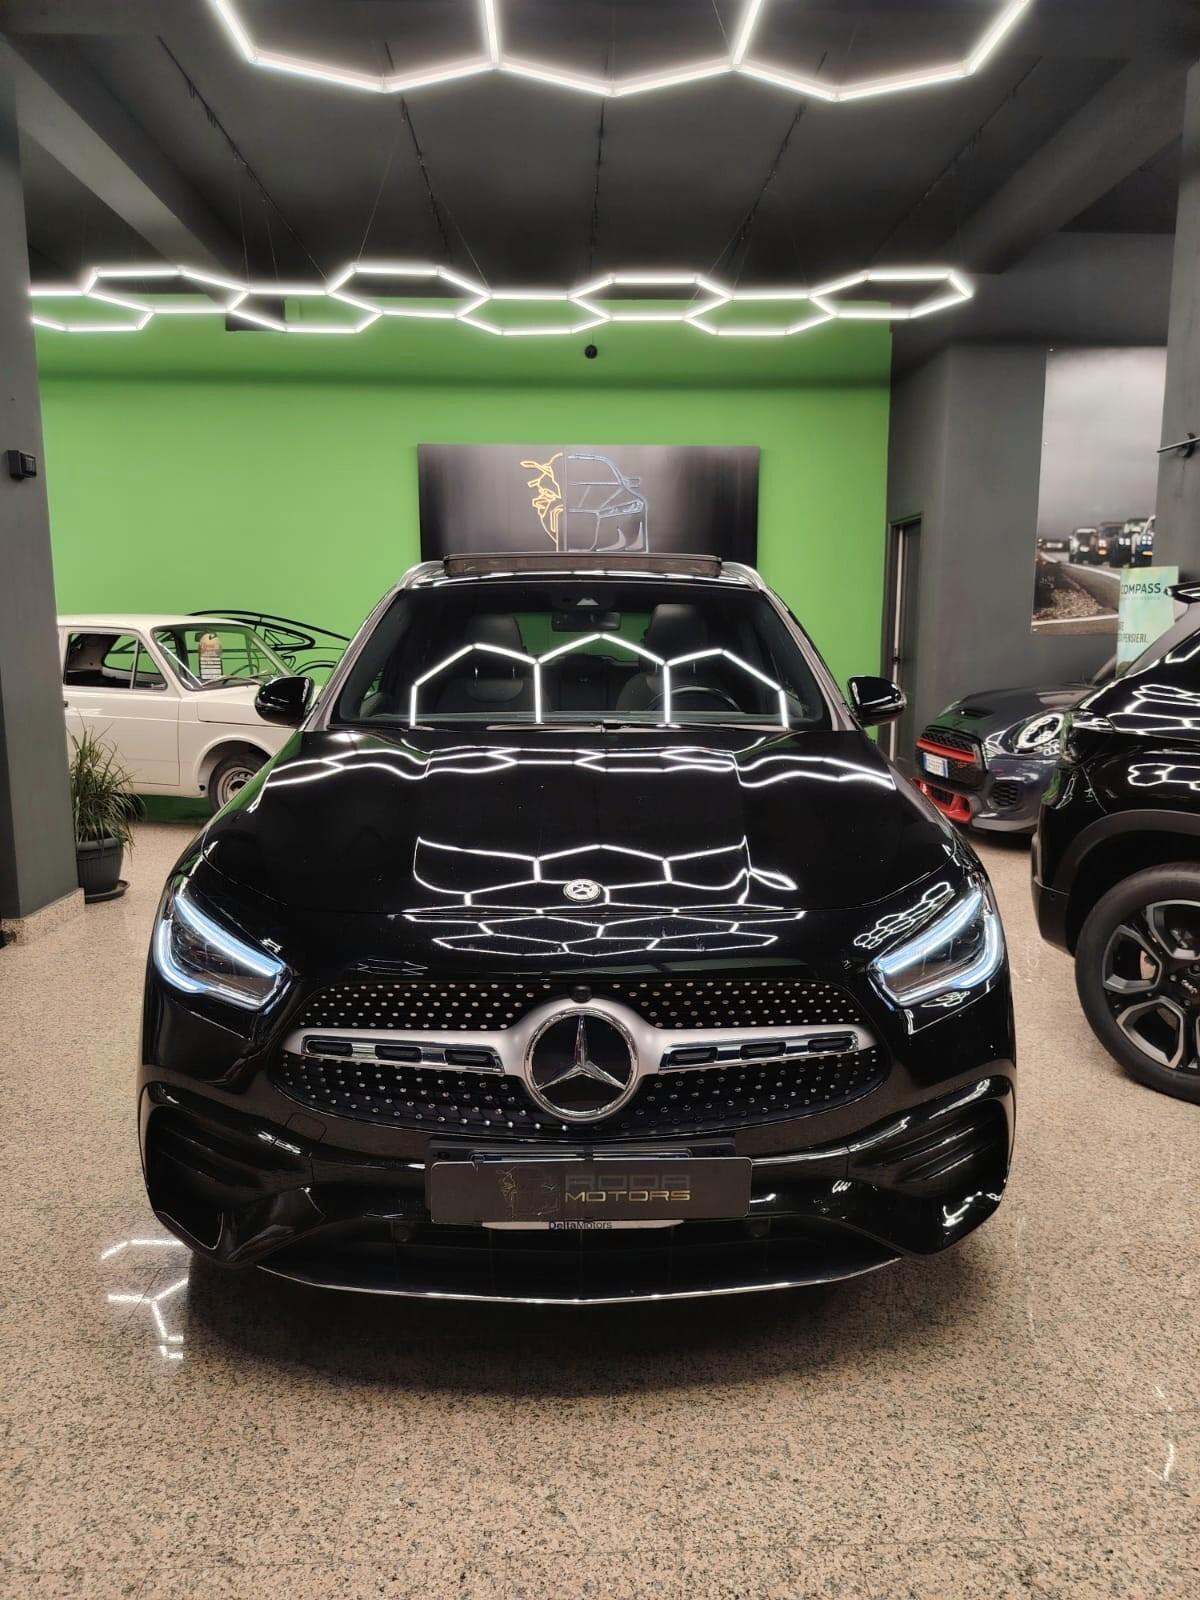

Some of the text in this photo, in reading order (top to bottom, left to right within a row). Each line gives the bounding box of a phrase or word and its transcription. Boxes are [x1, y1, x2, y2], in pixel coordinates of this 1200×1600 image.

[1120, 583, 1161, 595] COMPASS
[564, 1190, 690, 1202] MOTORS
[549, 1220, 613, 1230] DeltaMotors
